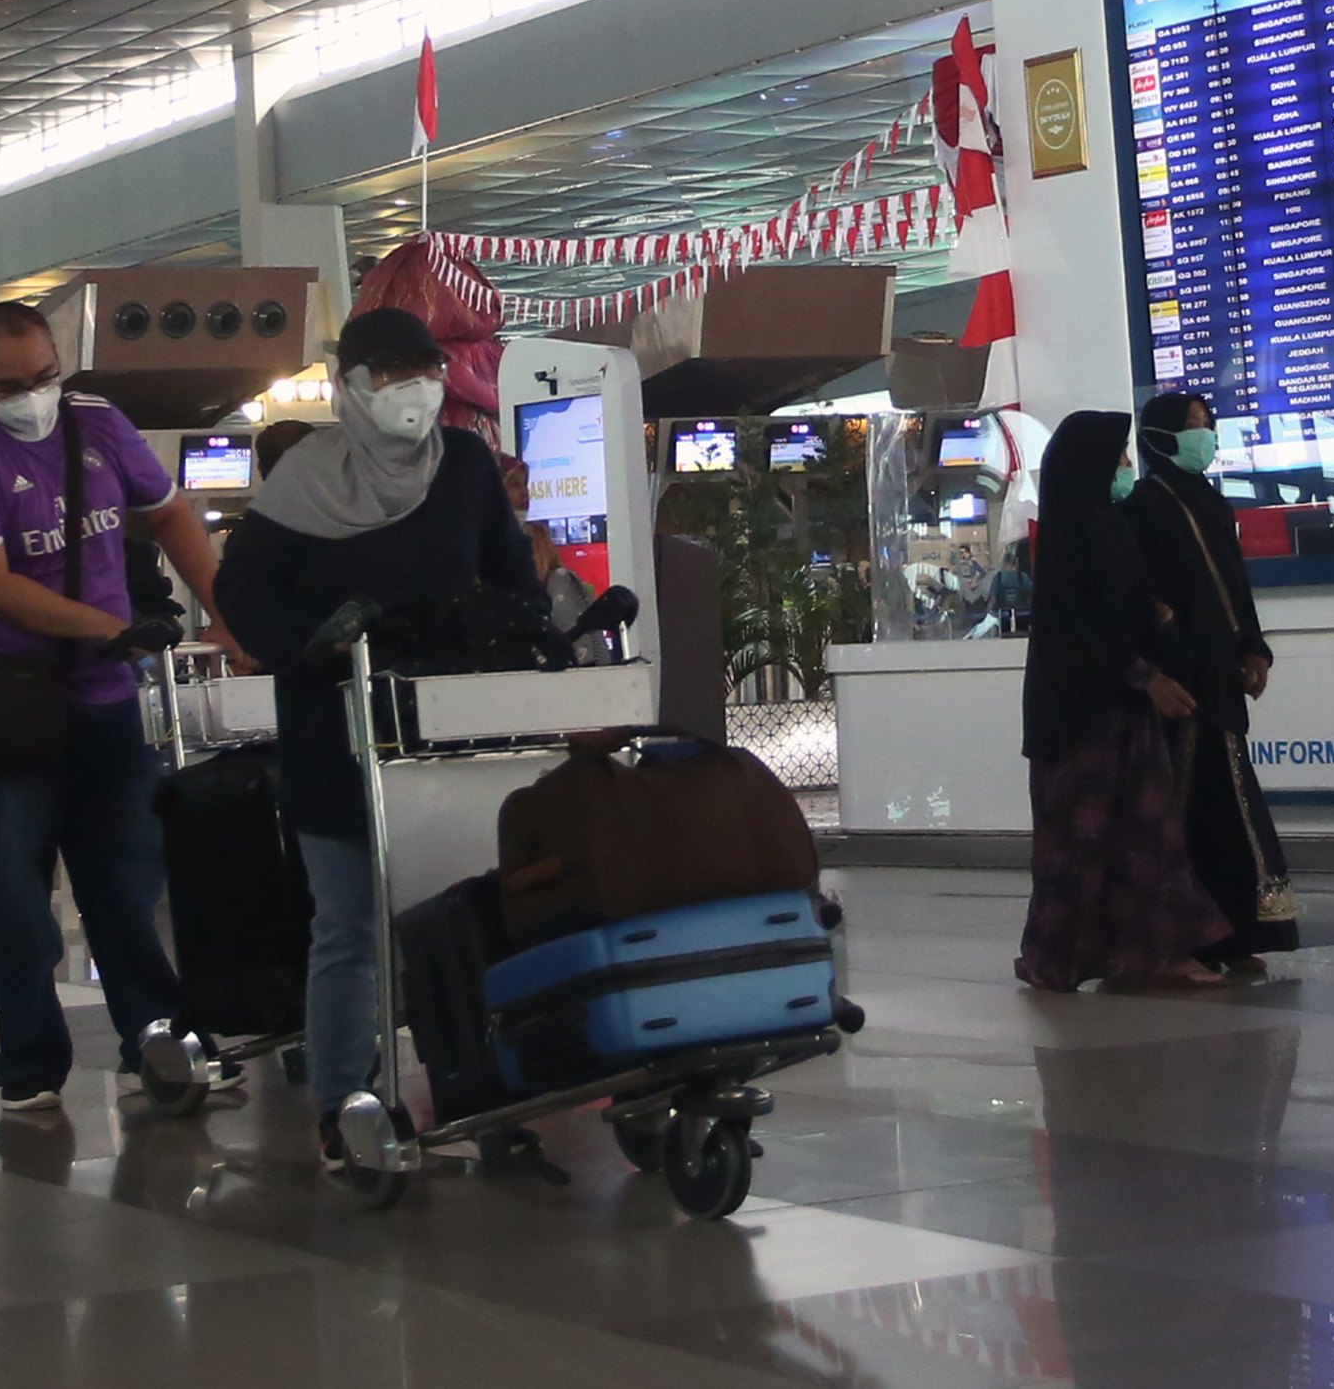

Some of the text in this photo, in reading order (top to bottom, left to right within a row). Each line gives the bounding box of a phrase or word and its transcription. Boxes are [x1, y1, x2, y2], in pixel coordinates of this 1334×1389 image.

[1246, 42, 1315, 64] KUALA LUMPUR
[529, 476, 588, 501] ASK HERE
